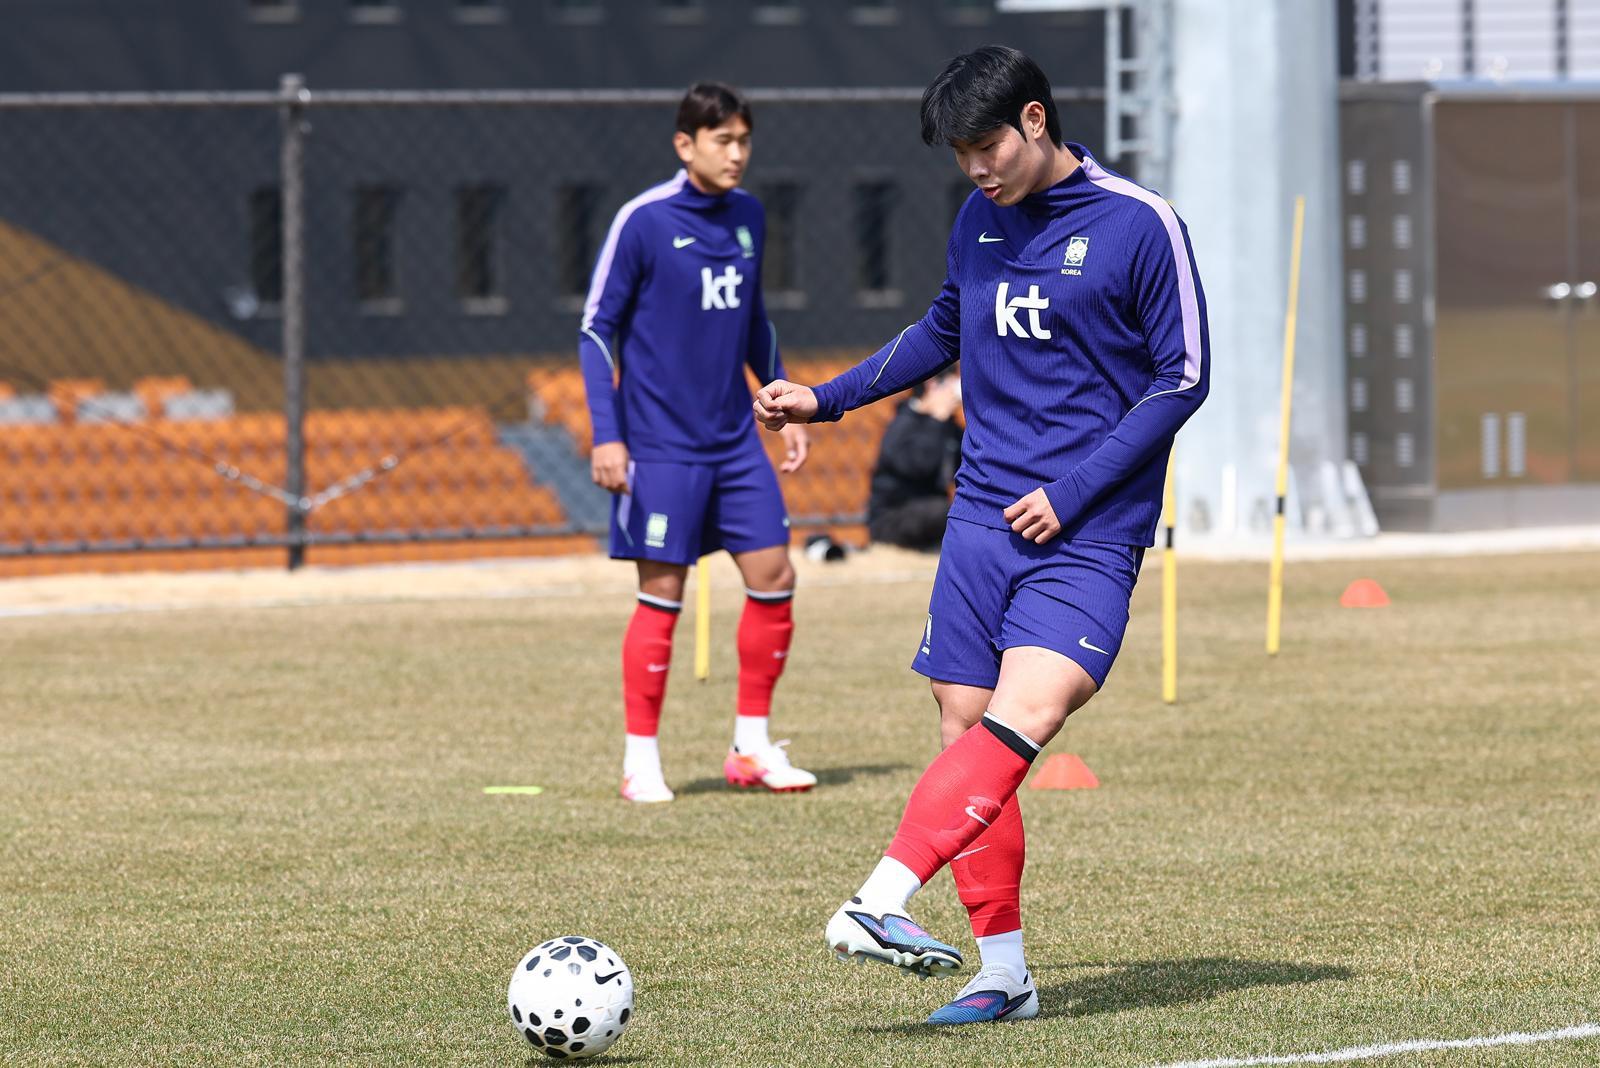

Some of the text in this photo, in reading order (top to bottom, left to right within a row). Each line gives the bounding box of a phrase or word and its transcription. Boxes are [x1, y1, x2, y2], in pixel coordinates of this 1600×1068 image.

[701, 265, 743, 310] kt
[1060, 268, 1082, 276] KOREA
[995, 282, 1052, 340] kt
